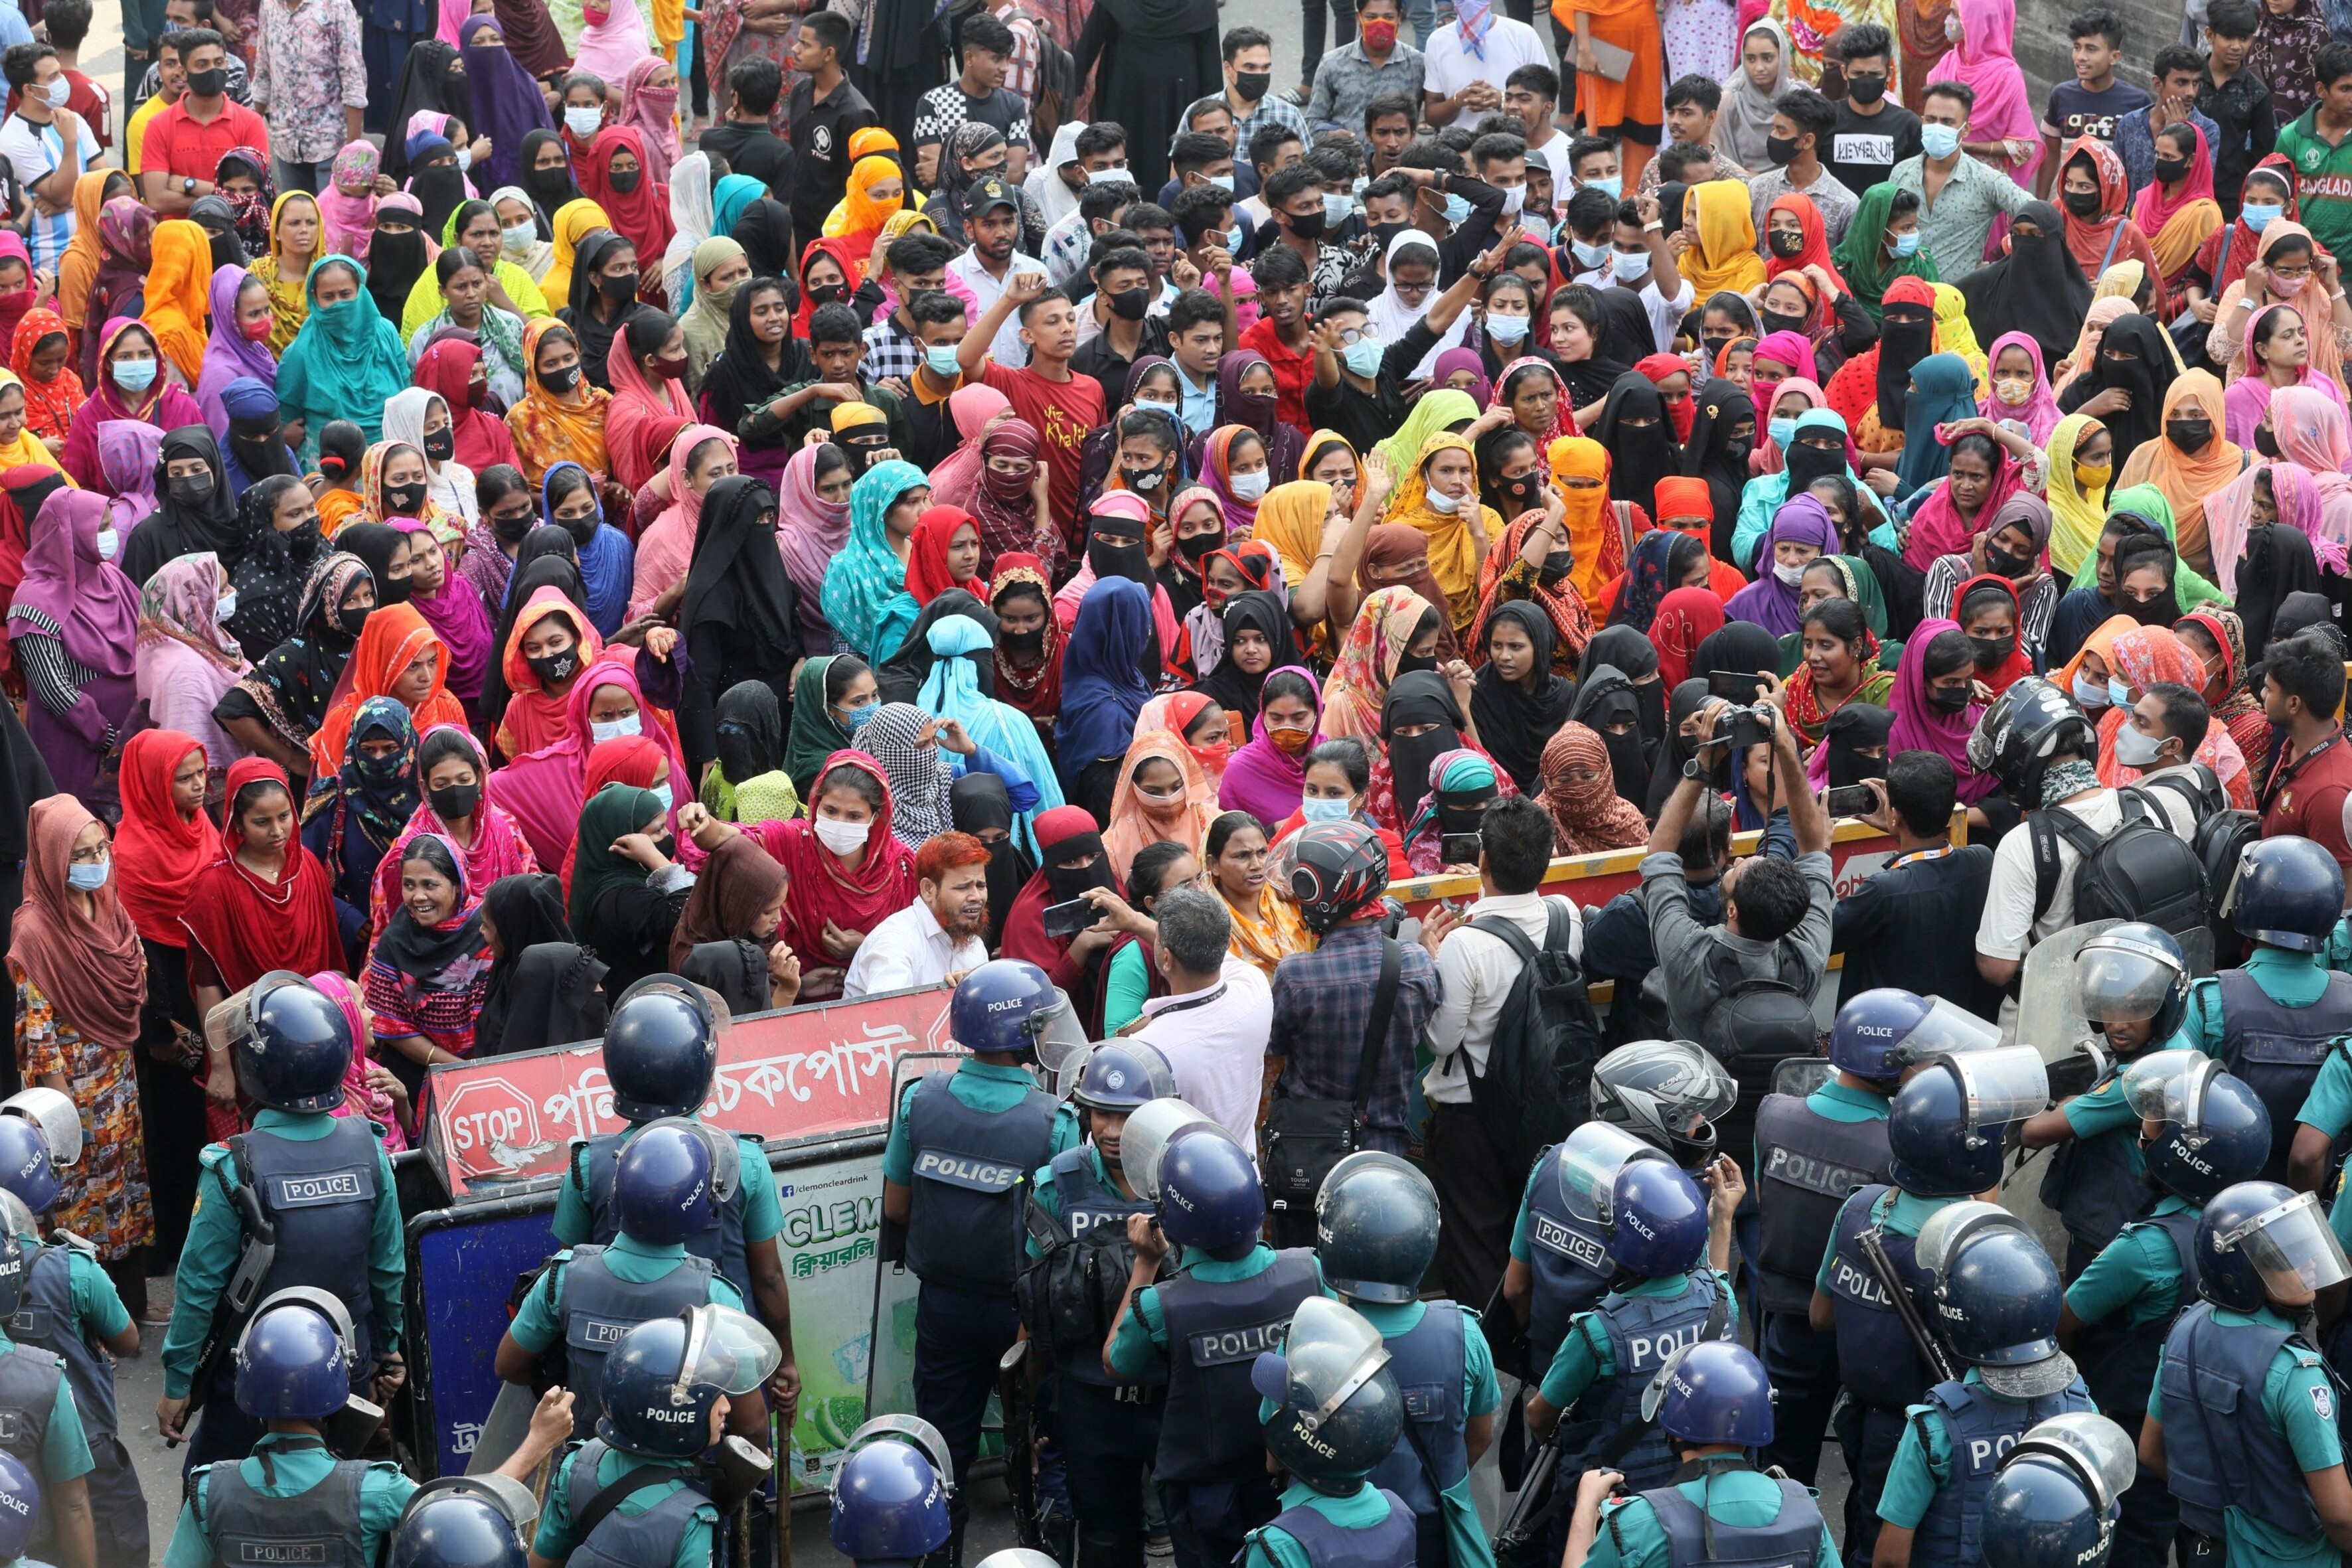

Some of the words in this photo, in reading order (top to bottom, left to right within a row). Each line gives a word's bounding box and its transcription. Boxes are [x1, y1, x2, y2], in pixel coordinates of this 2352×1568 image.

[2300, 177, 2352, 197] BANGLAD
[1046, 422, 1089, 449] Khalif
[2310, 740, 2329, 756] PRESS
[1333, 868, 1348, 893] URBAN
[987, 998, 1023, 1012] POLICE
[1857, 1026, 1893, 1038] POLICE
[455, 1107, 523, 1149] STOP
[21, 1150, 43, 1178] POLICE
[919, 1154, 1013, 1186] POLICE
[2170, 1139, 2213, 1175] POLICE
[290, 1178, 352, 1197] POLICE
[680, 1179, 704, 1211] POLICE
[796, 1174, 868, 1194] /clemoncleardrink
[1167, 1184, 1194, 1212] POLICE
[781, 1196, 882, 1248] CLEM
[1624, 1210, 1655, 1241] POLICE
[1541, 1223, 1597, 1260] POLICE
[0, 1259, 20, 1276] OLICE
[1938, 1302, 1964, 1320] POLICE
[1204, 1323, 1284, 1358] POLIC
[1673, 1374, 1693, 1399] POLICE
[646, 1408, 696, 1424] POLICE
[1293, 1421, 1336, 1459] POLICE
[254, 1545, 311, 1561] POLICE
[2077, 1535, 2110, 1565] POLICE
